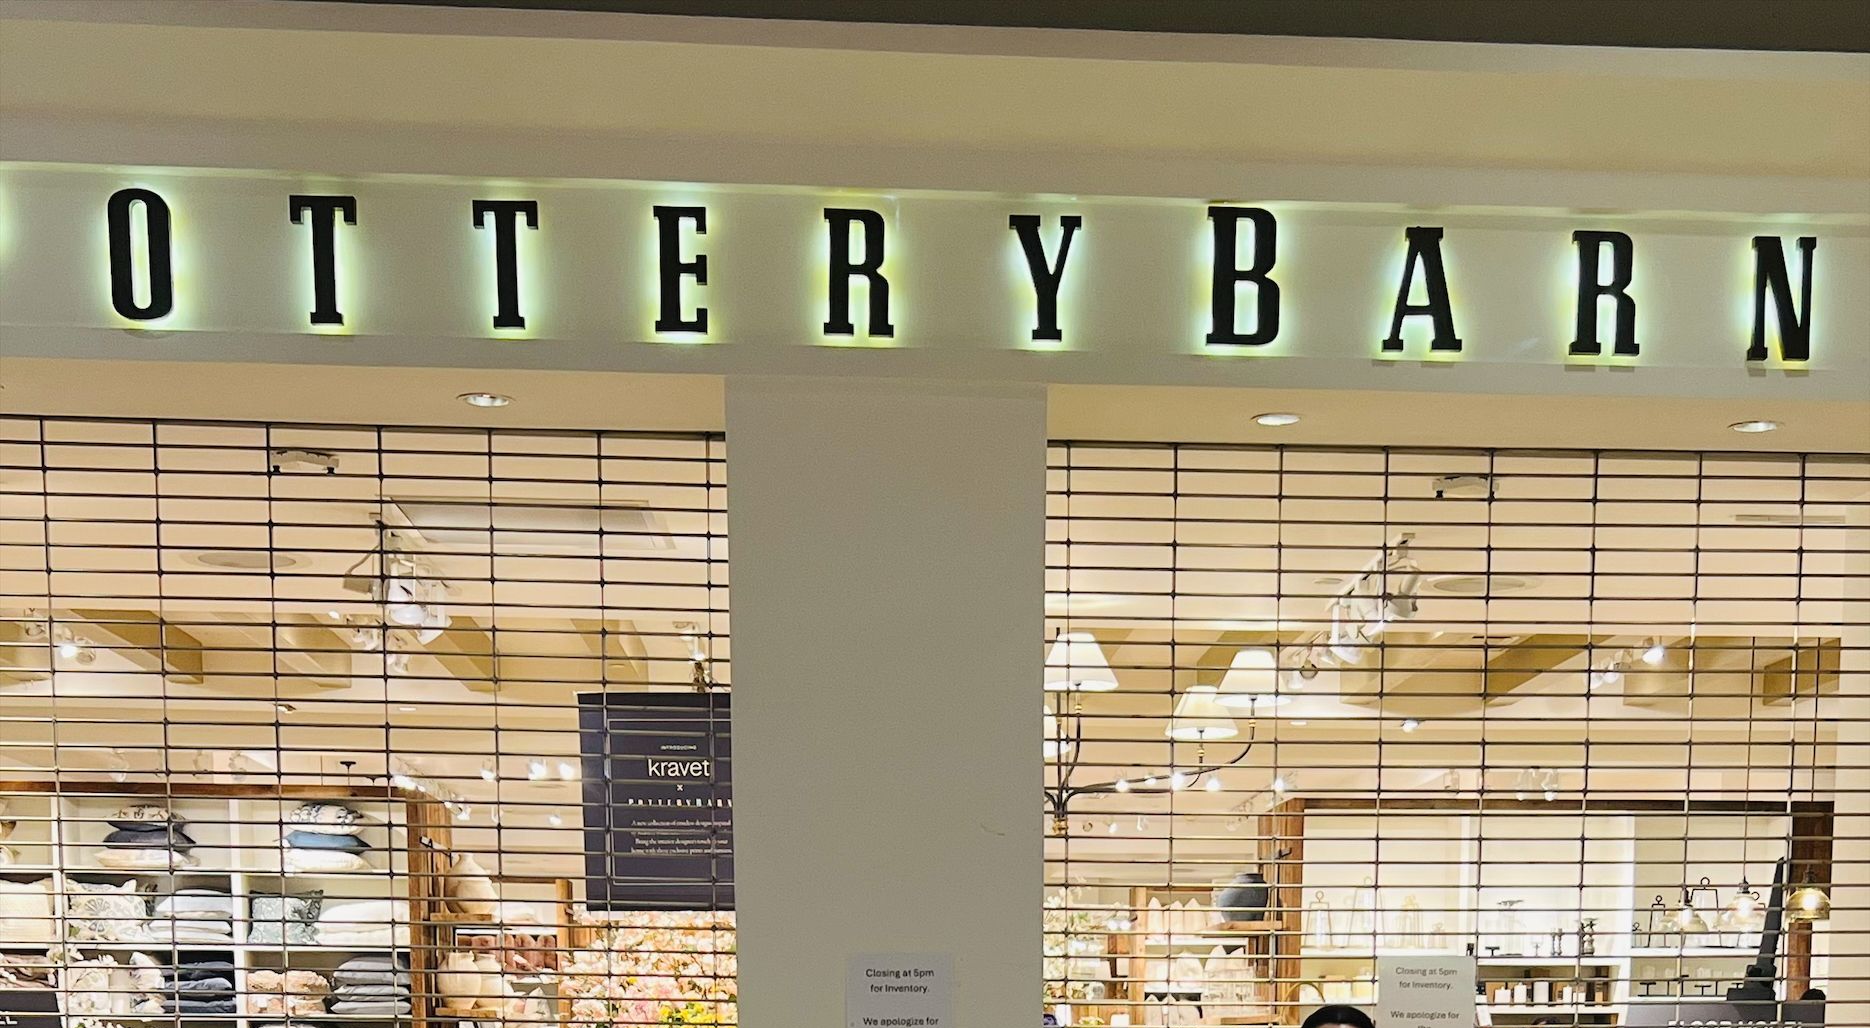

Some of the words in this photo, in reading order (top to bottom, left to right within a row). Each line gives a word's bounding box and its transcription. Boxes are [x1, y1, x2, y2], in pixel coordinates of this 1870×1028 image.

[647, 759, 710, 777] kravet
[865, 968, 901, 979] Closing
[902, 969, 912, 977] at
[913, 968, 935, 979] 5pm
[1395, 966, 1427, 977] Closing
[1428, 967, 1438, 976] at
[1438, 967, 1458, 977] 5pm
[870, 983, 883, 993] for
[885, 984, 930, 994] Inventory.
[1399, 981, 1411, 989] for
[1412, 981, 1454, 991] Inventory.
[1390, 1010, 1405, 1019] We
[1406, 1010, 1446, 1020] apologize
[1447, 1011, 1460, 1019] for
[862, 1017, 879, 1026] We
[880, 1017, 924, 1028] apologize
[926, 1017, 939, 1026] for
